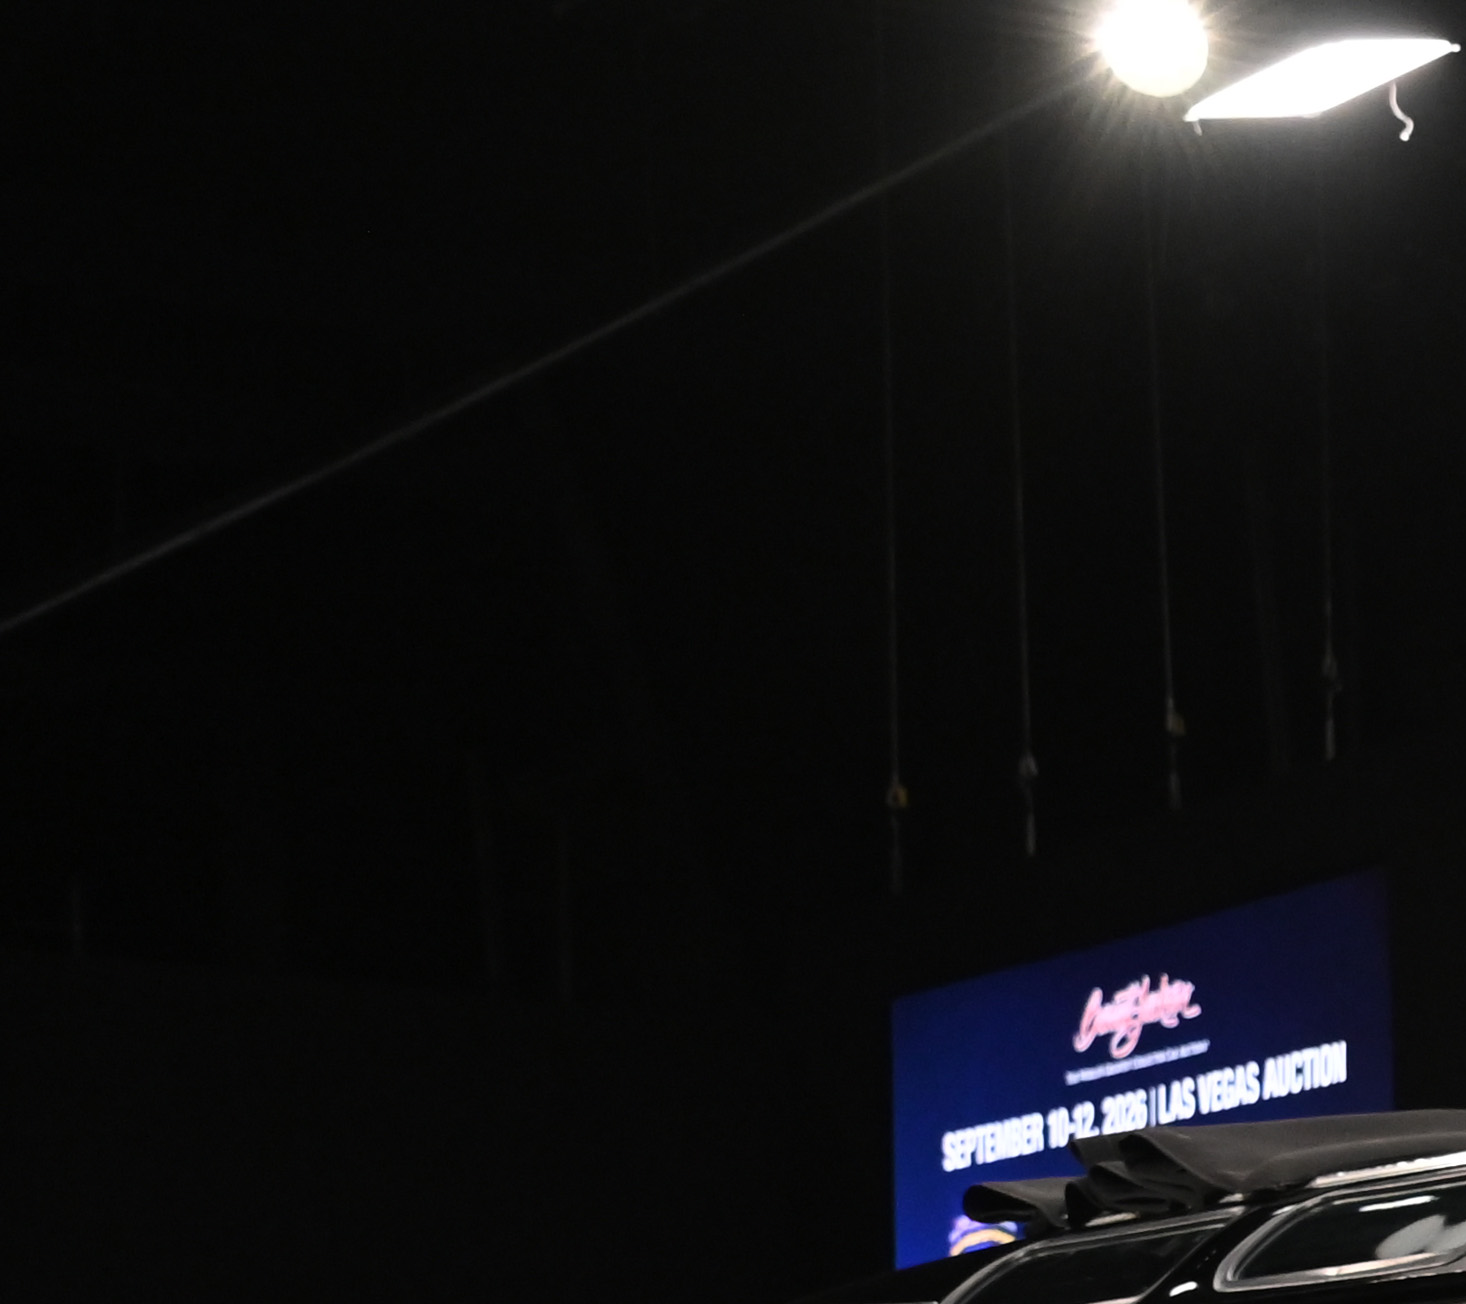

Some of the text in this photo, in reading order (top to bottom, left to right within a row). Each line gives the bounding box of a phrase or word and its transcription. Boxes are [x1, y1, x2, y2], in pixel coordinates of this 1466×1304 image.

[941, 1112, 1045, 1173] SEPTEMBER
[1101, 1087, 1148, 1136] 2026
[1157, 1076, 1197, 1125] LAS
[1196, 1060, 1261, 1115] VEGAS
[1262, 1039, 1348, 1101] AUCTION
